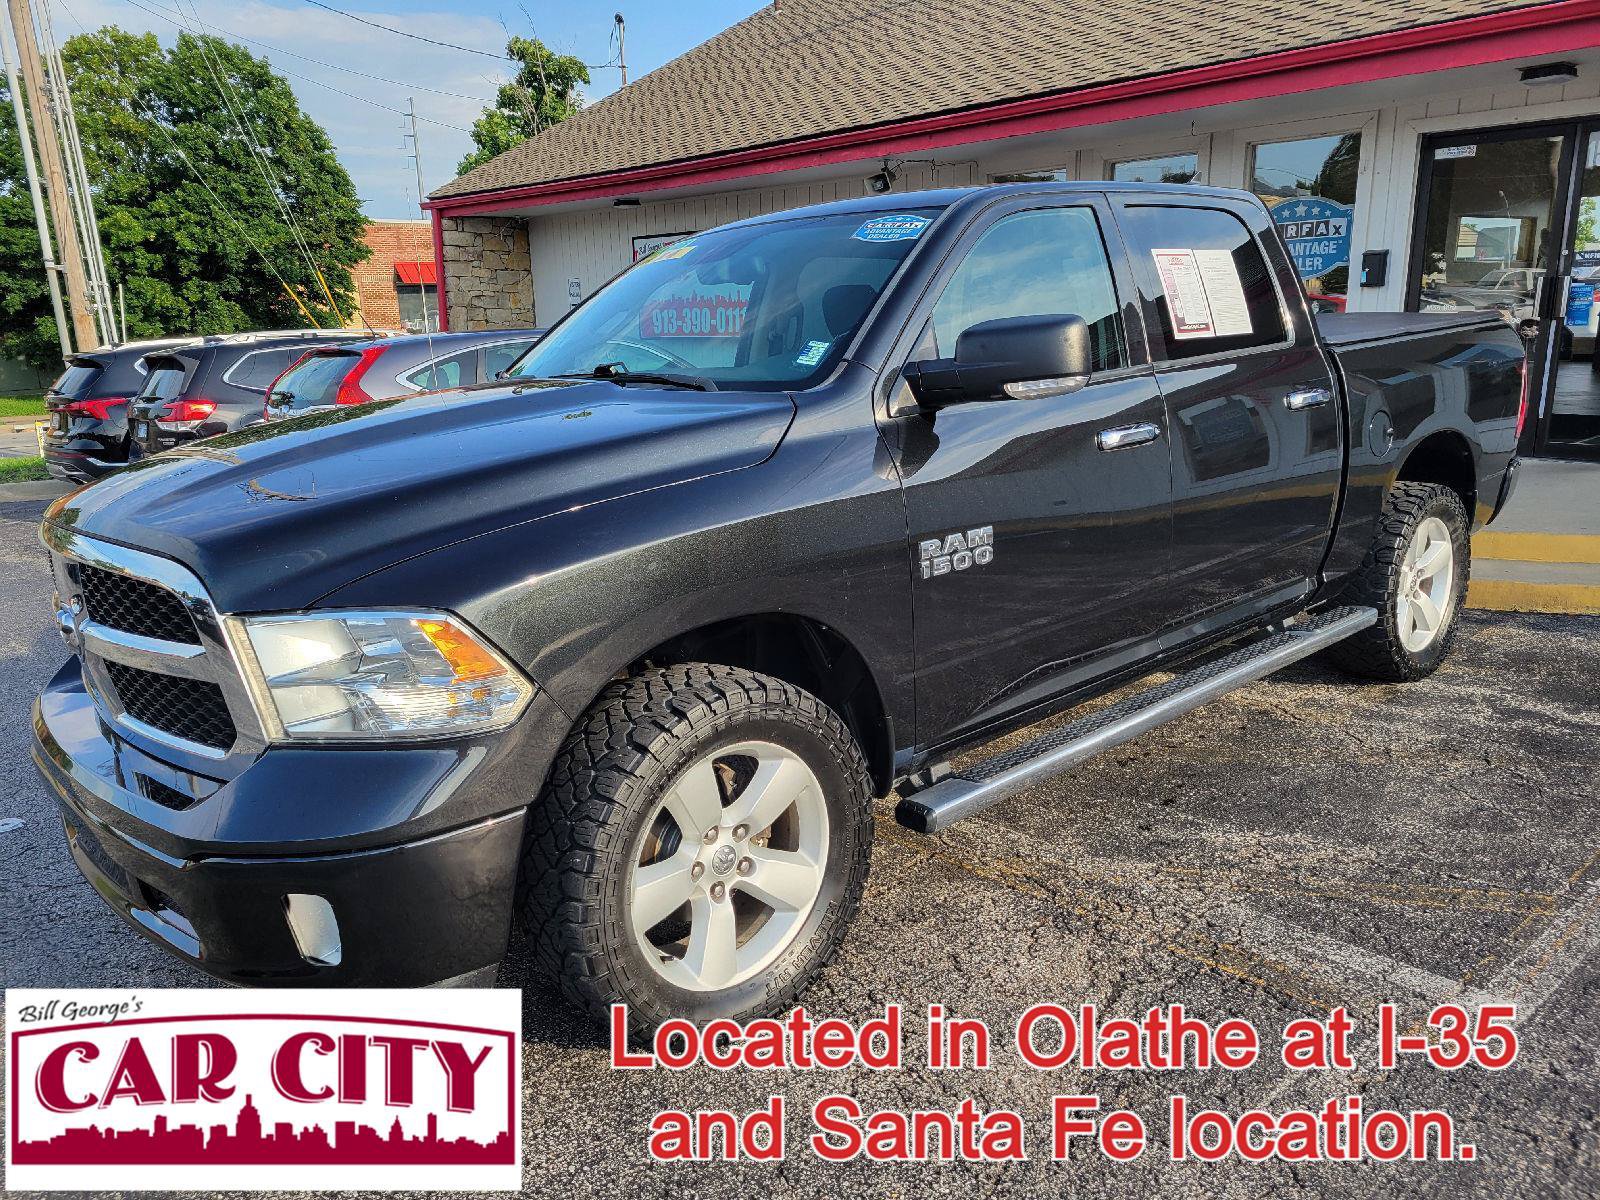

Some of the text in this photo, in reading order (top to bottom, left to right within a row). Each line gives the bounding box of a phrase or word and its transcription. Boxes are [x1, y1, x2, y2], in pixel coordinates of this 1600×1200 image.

[1286, 222, 1343, 238] RFAX
[1287, 240, 1337, 257] ANTAGE
[1294, 256, 1323, 271] LER
[918, 525, 994, 560] RAM
[918, 545, 994, 580] 1500
